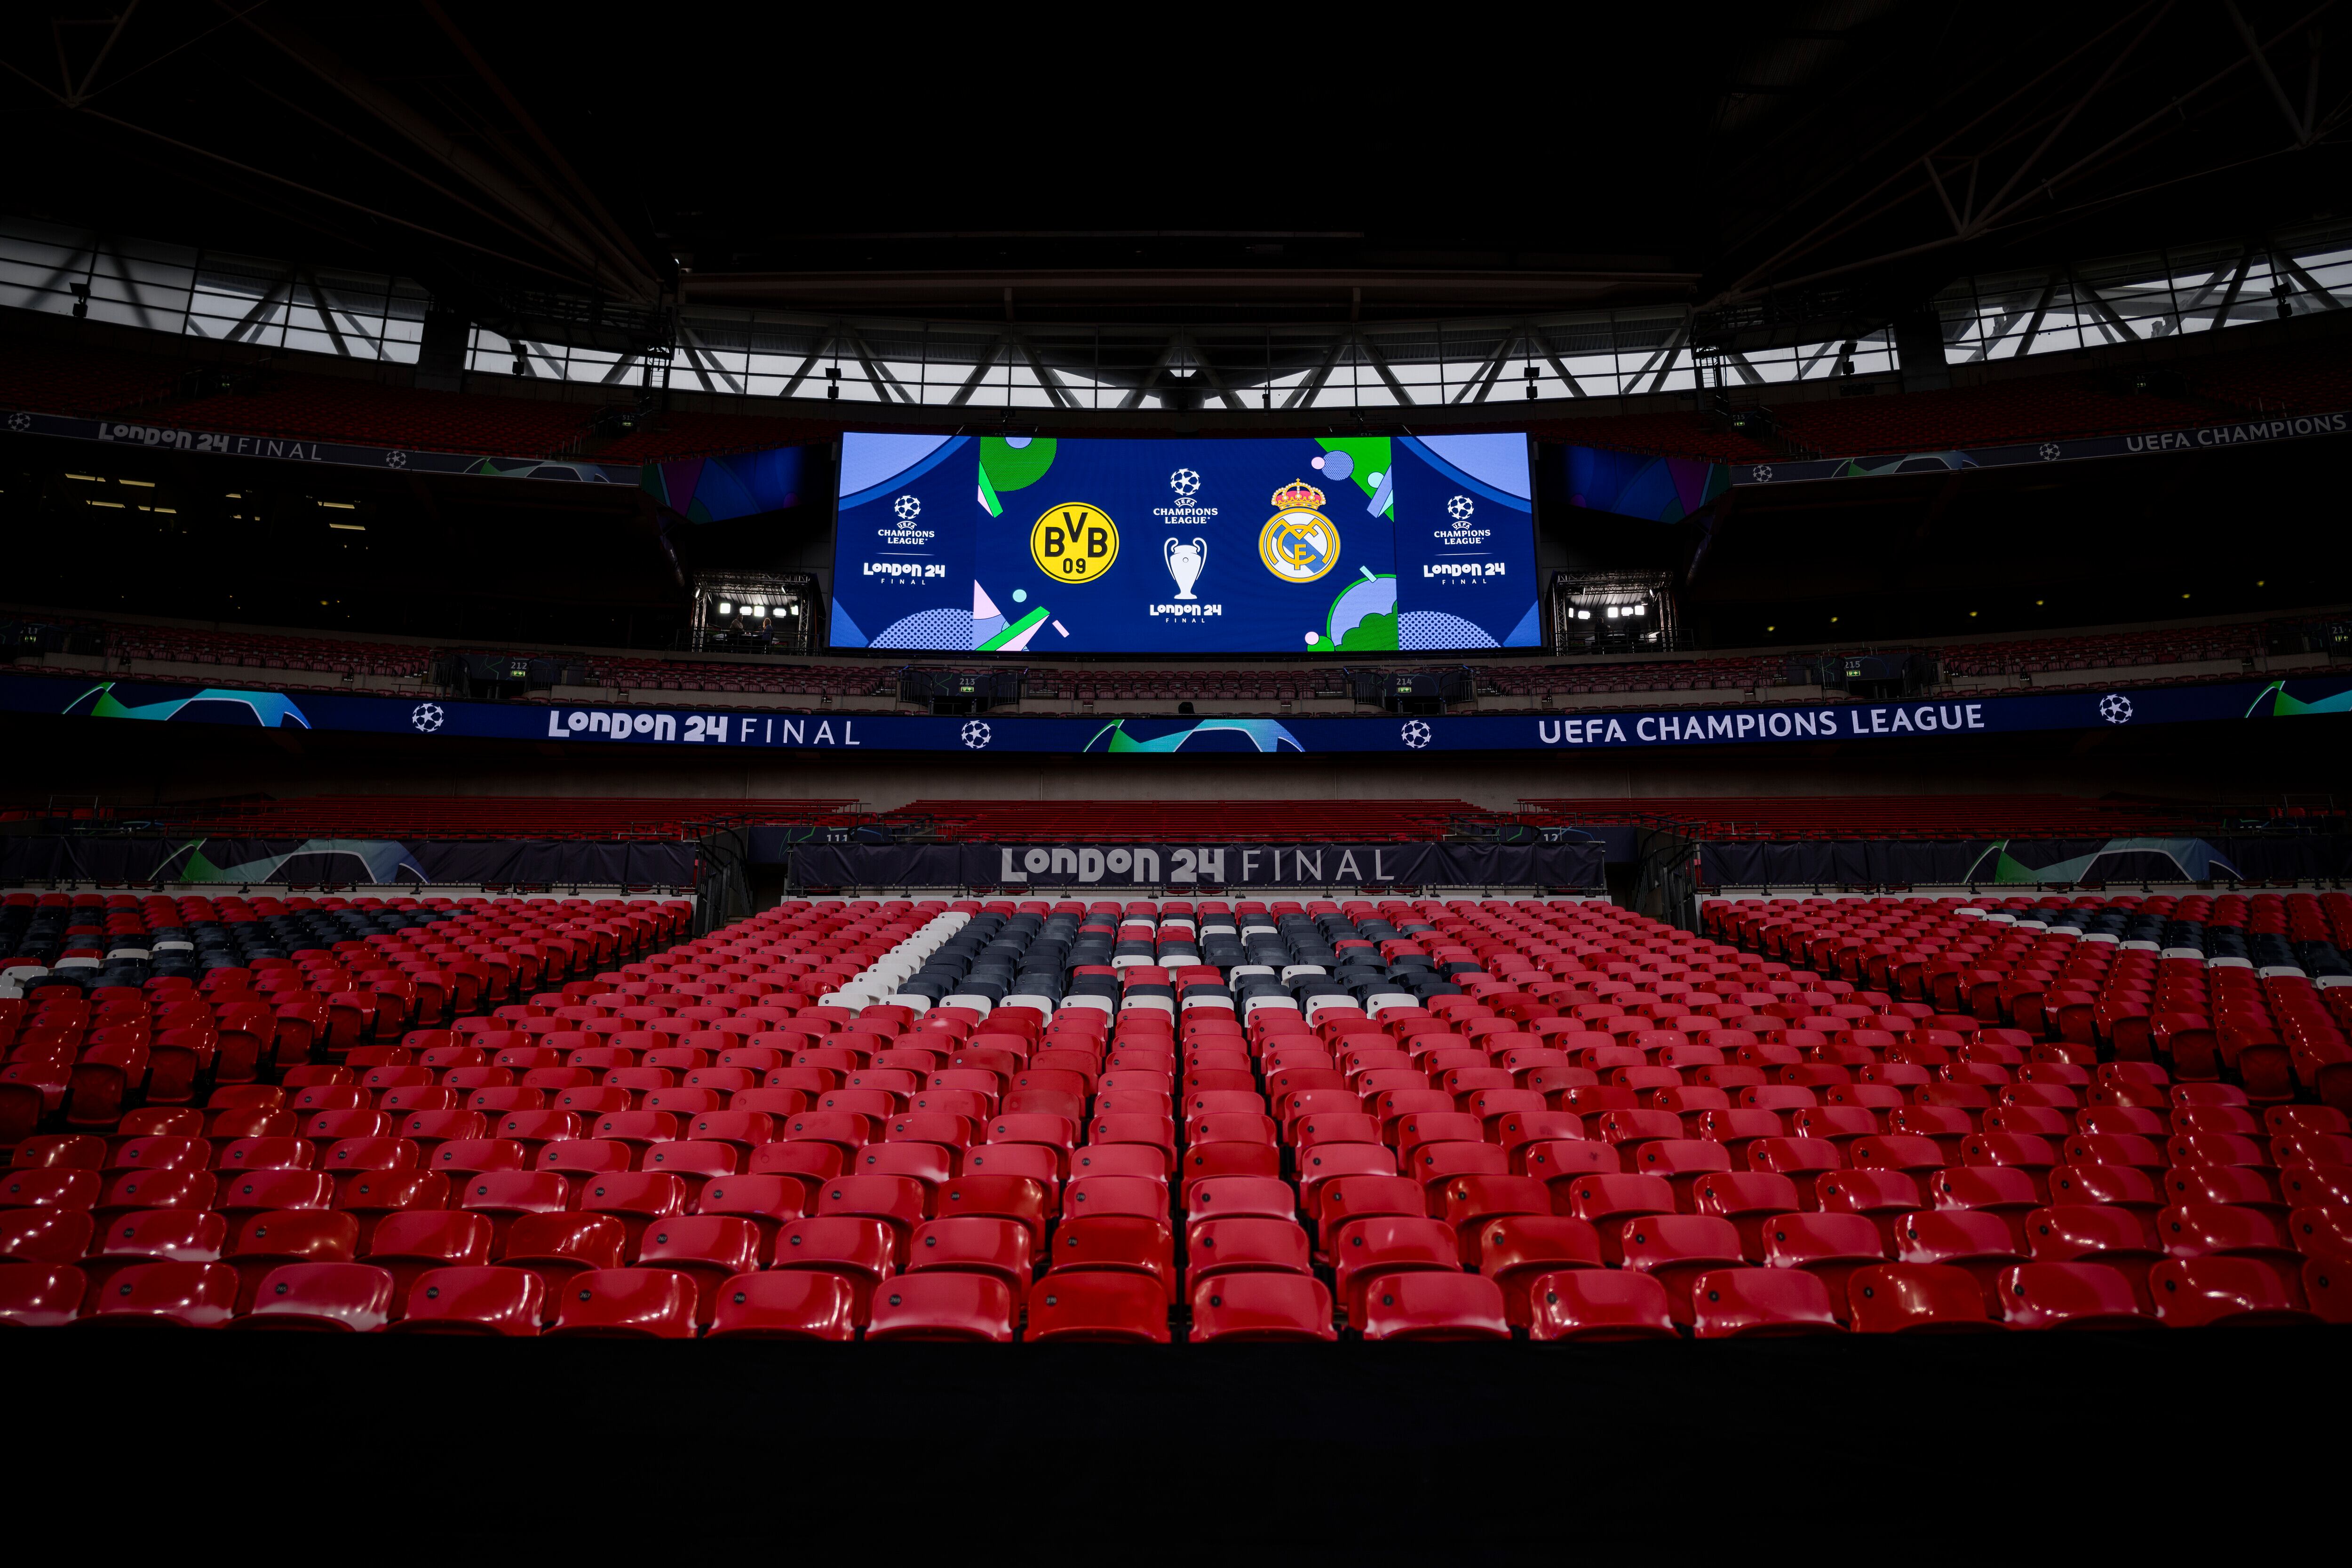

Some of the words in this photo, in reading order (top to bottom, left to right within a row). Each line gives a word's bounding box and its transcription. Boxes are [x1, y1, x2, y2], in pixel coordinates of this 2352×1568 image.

[2126, 432, 2191, 452] UEFA
[2197, 414, 2347, 445] CHAMPIONS
[197, 434, 229, 452] 24
[238, 438, 322, 461] FINAL
[1045, 512, 1107, 557] BVB
[925, 565, 945, 577] 24
[1063, 558, 1086, 574] 09
[1485, 563, 1505, 575] 24
[1204, 605, 1221, 615] 24
[684, 716, 728, 742] 24
[741, 718, 860, 744] FINAL
[1539, 719, 1626, 743] UEFA
[1637, 711, 1836, 740] CHAMPIONS
[1851, 705, 1984, 733] LEAGUE
[1171, 849, 1224, 882] 24
[1243, 849, 1394, 881] FINAL
